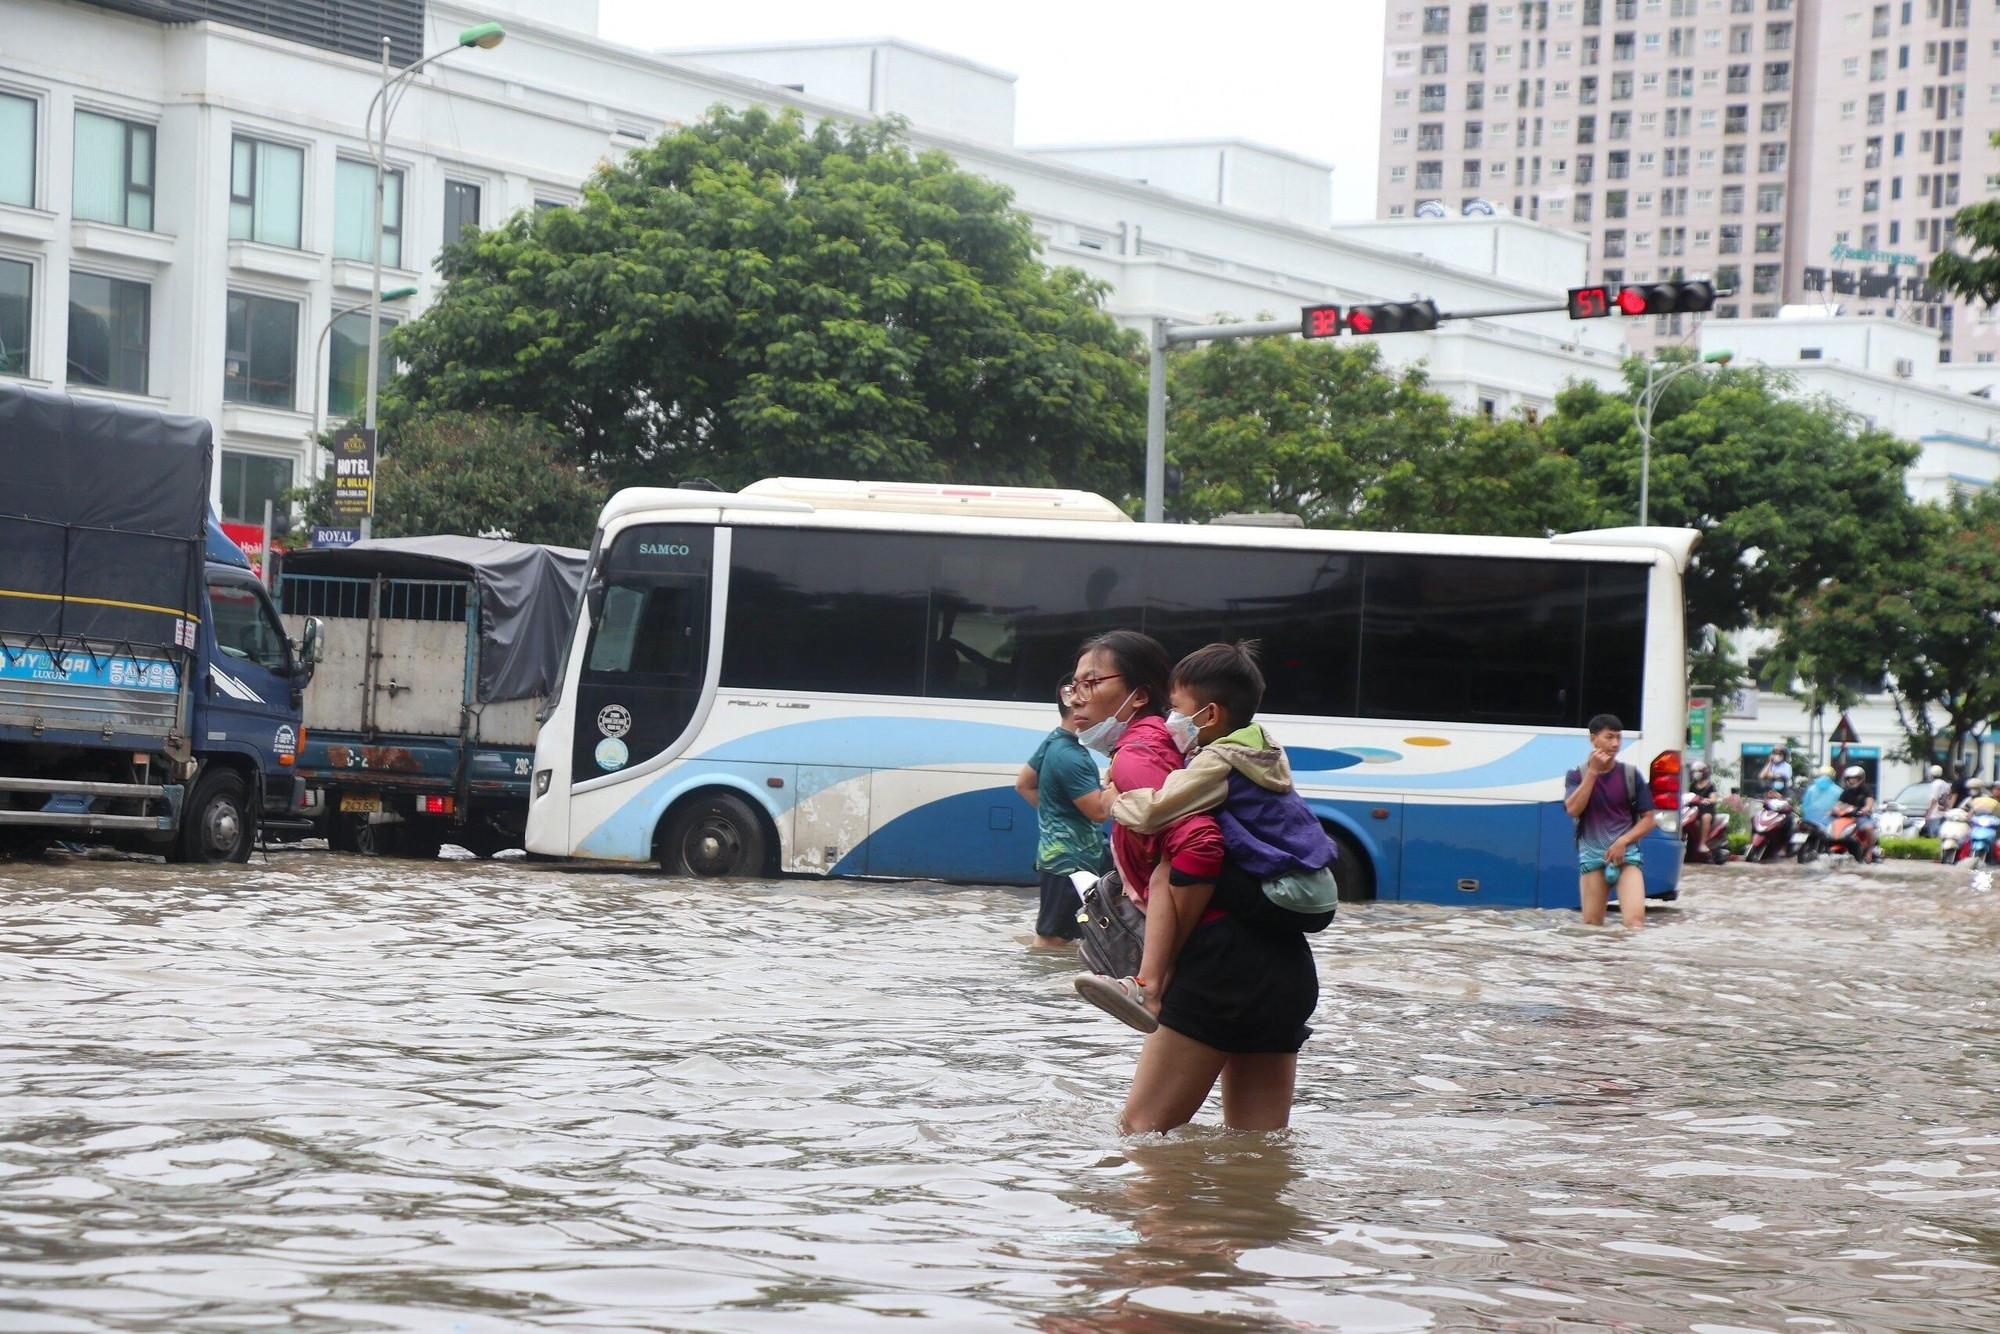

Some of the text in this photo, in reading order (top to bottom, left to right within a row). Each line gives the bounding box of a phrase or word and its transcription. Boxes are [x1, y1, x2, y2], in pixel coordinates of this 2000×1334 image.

[1576, 289, 1606, 316] 57
[1311, 309, 1336, 336] 32
[337, 459, 371, 476] HOTEL
[317, 530, 354, 543] ROYAL
[639, 543, 689, 556] SAMCO
